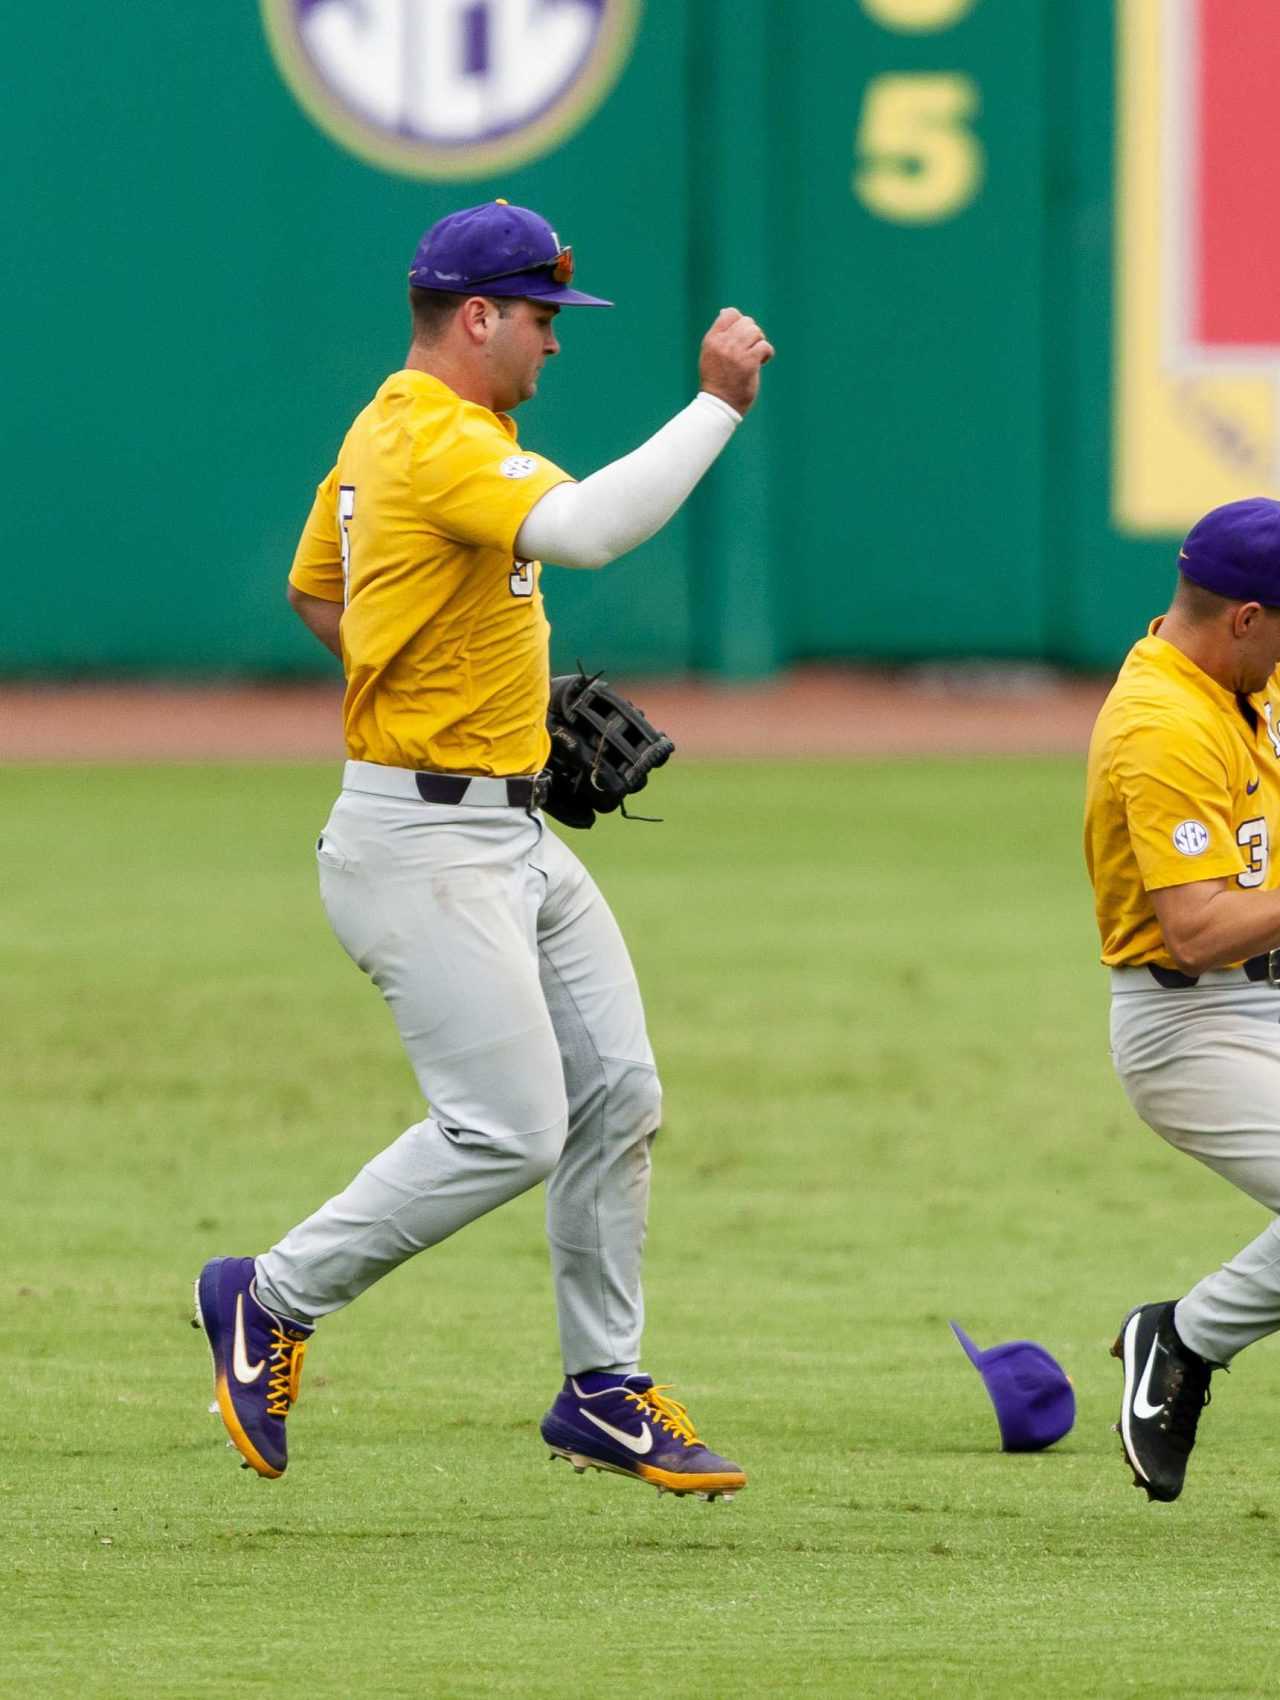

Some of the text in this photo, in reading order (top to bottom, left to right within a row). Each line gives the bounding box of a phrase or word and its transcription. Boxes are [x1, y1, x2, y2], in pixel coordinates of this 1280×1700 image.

[853, 70, 986, 226] 5
[1175, 820, 1208, 855] SEC
[1235, 816, 1269, 889] 3
